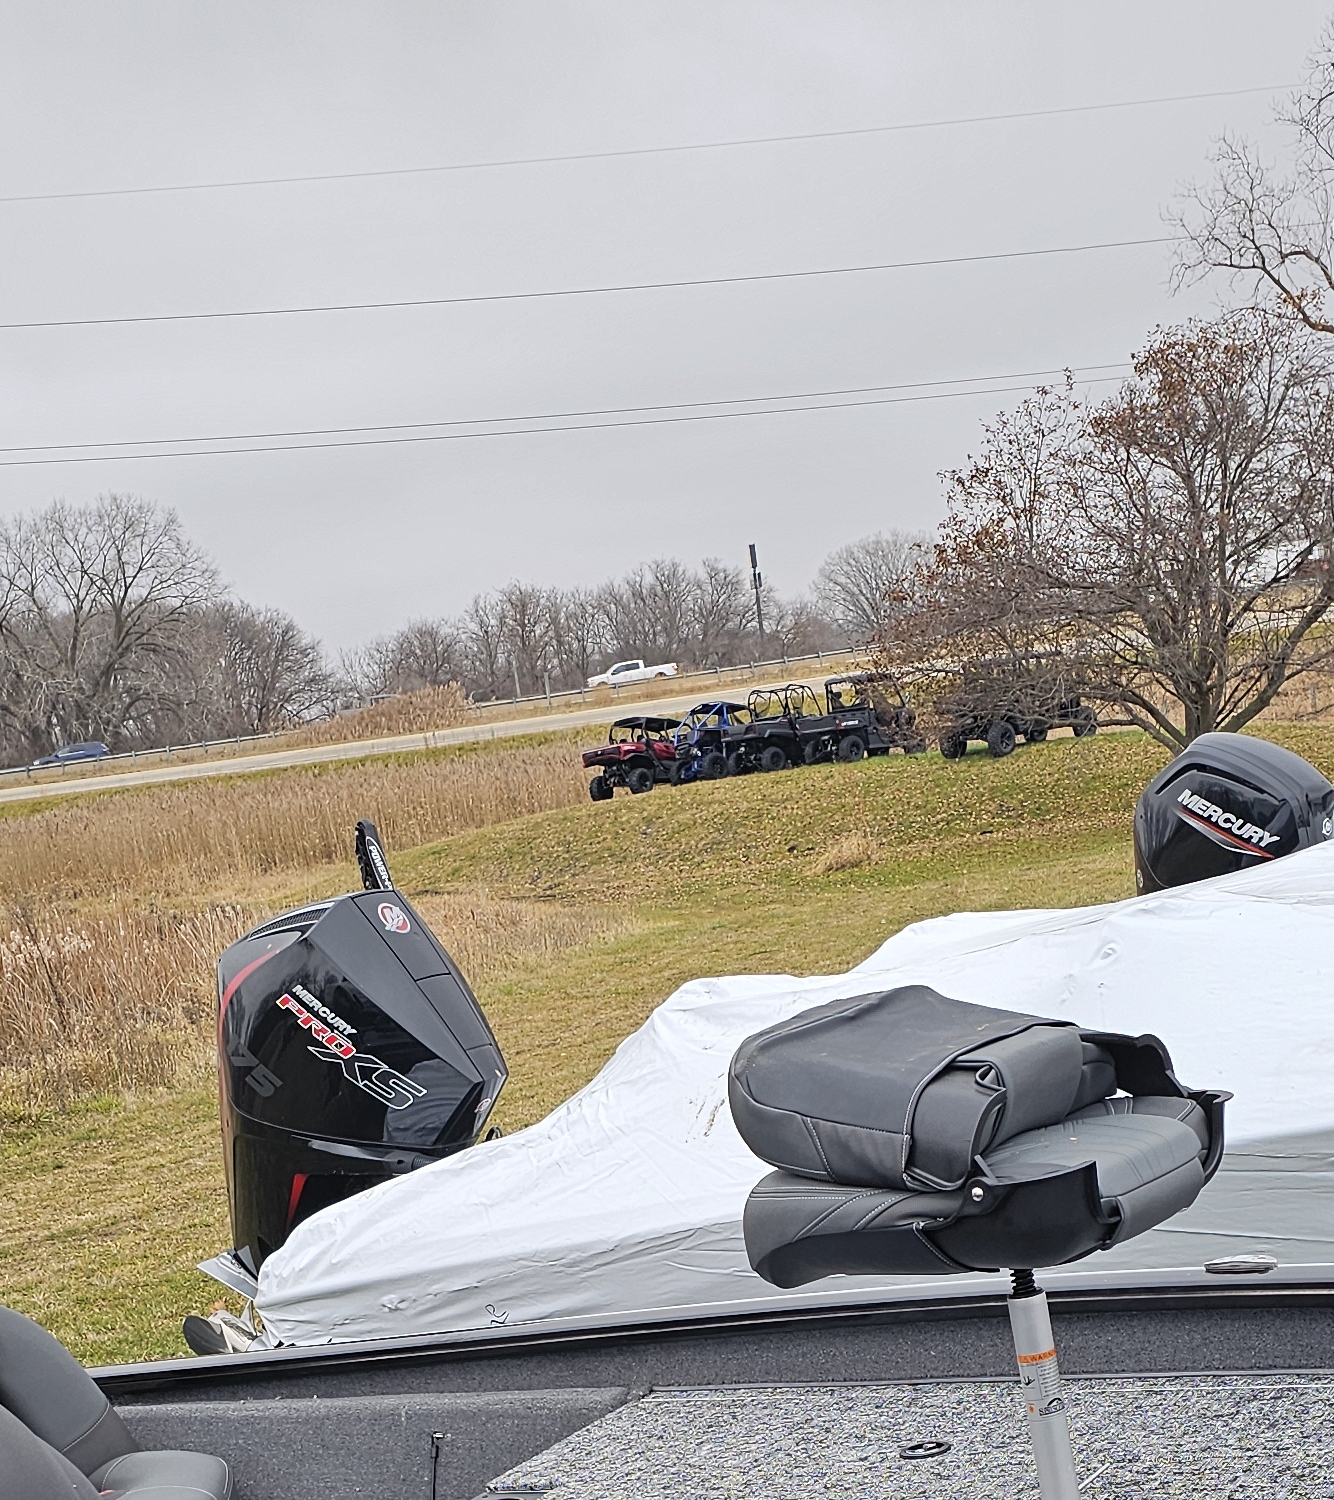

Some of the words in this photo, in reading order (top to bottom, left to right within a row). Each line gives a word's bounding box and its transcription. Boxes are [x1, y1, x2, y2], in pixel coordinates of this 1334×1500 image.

[1177, 789, 1280, 848] MERCURY
[275, 993, 356, 1059] PRO
[292, 984, 357, 1035] MERCURY
[306, 1045, 428, 1110] XS
